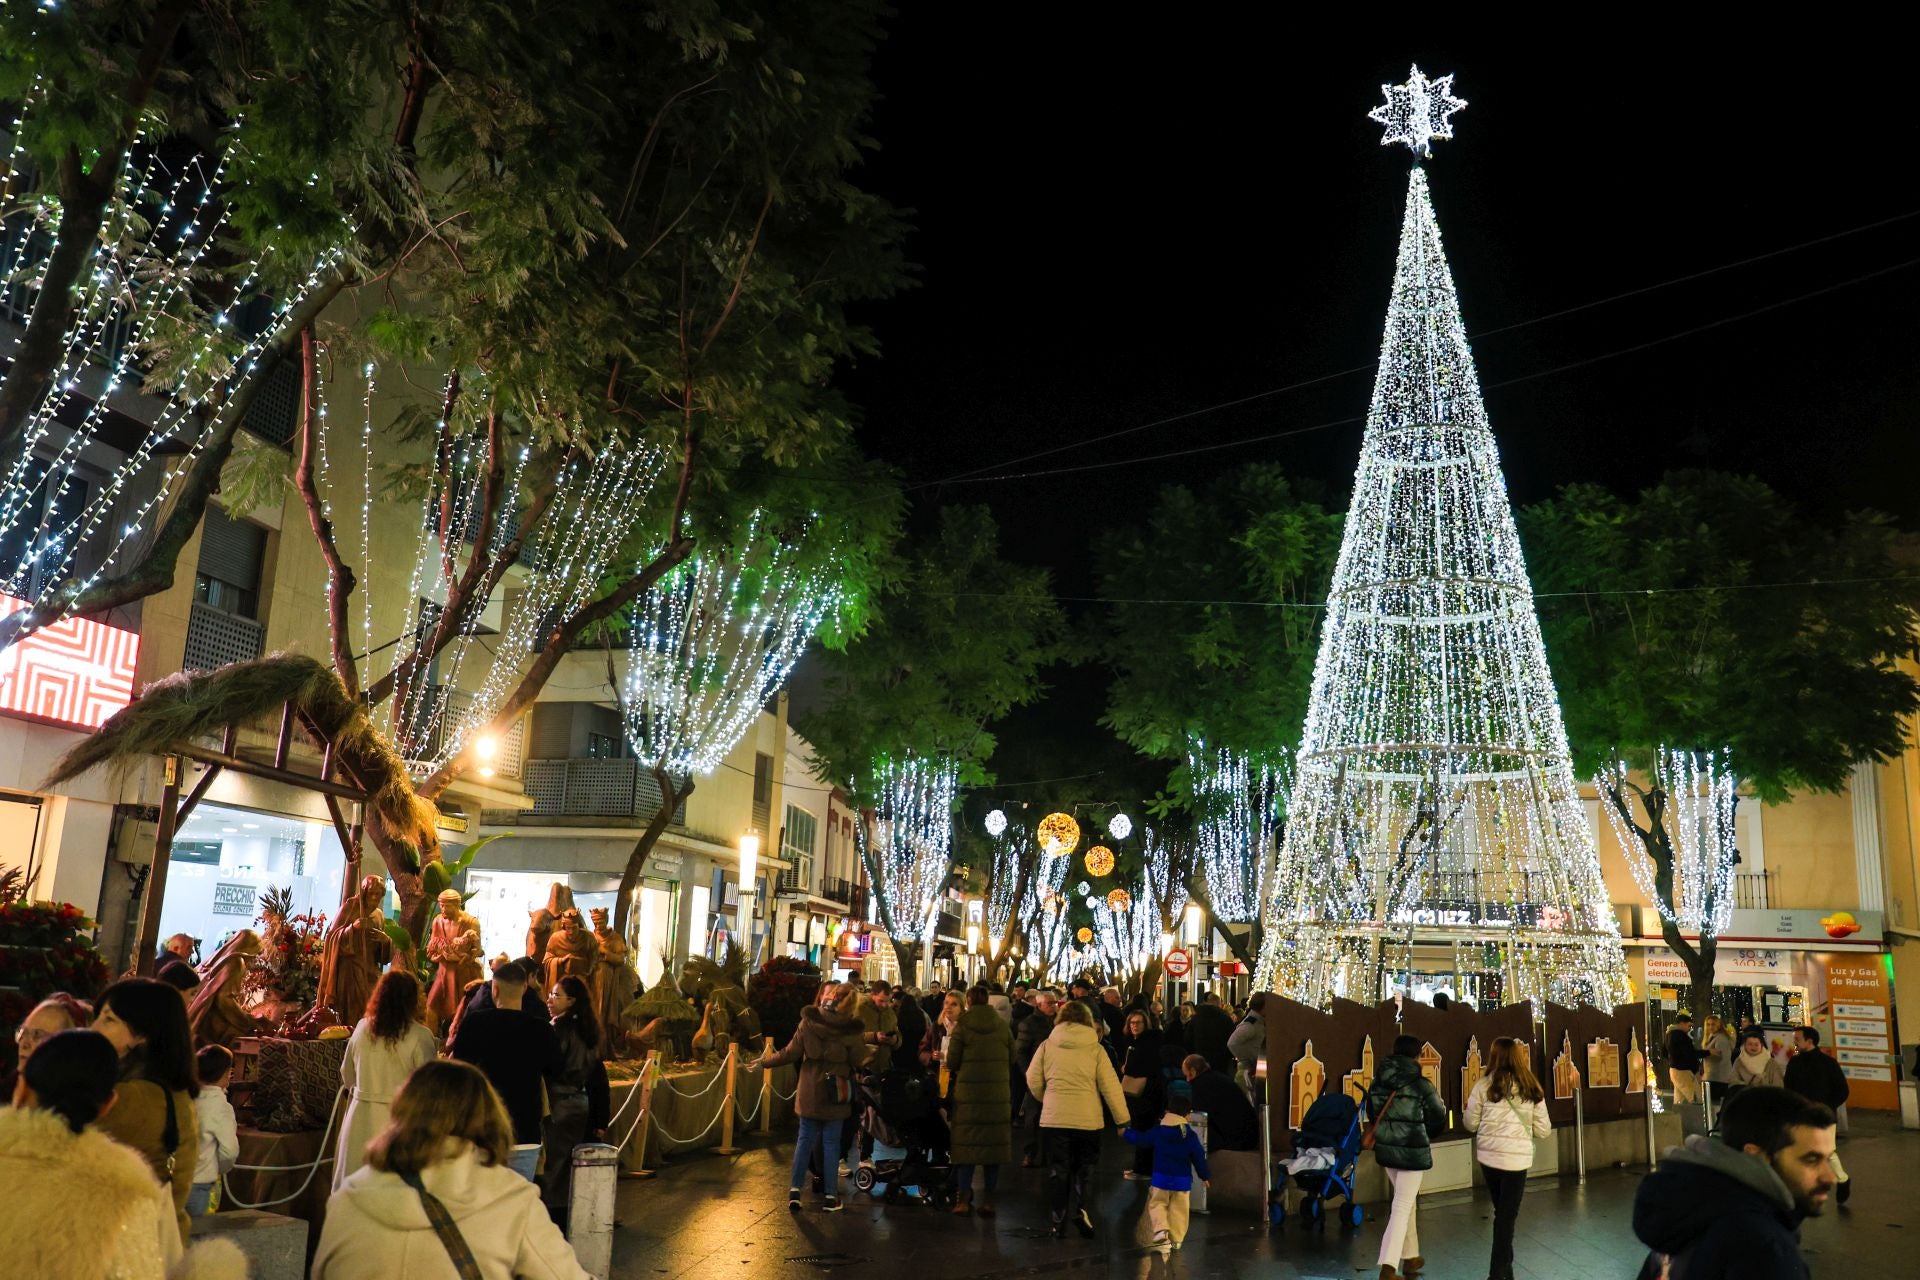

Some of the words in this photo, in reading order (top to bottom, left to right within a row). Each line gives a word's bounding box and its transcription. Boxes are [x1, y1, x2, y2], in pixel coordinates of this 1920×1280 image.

[214, 885, 256, 904] PRECCHIO
[1647, 958, 1678, 968] Genera
[1647, 969, 1691, 978] electricid
[1830, 967, 1847, 975] Luz
[1850, 969, 1856, 977] y
[1859, 968, 1877, 976] Gas
[1831, 977, 1843, 985] de
[1845, 978, 1880, 987] Repsol
